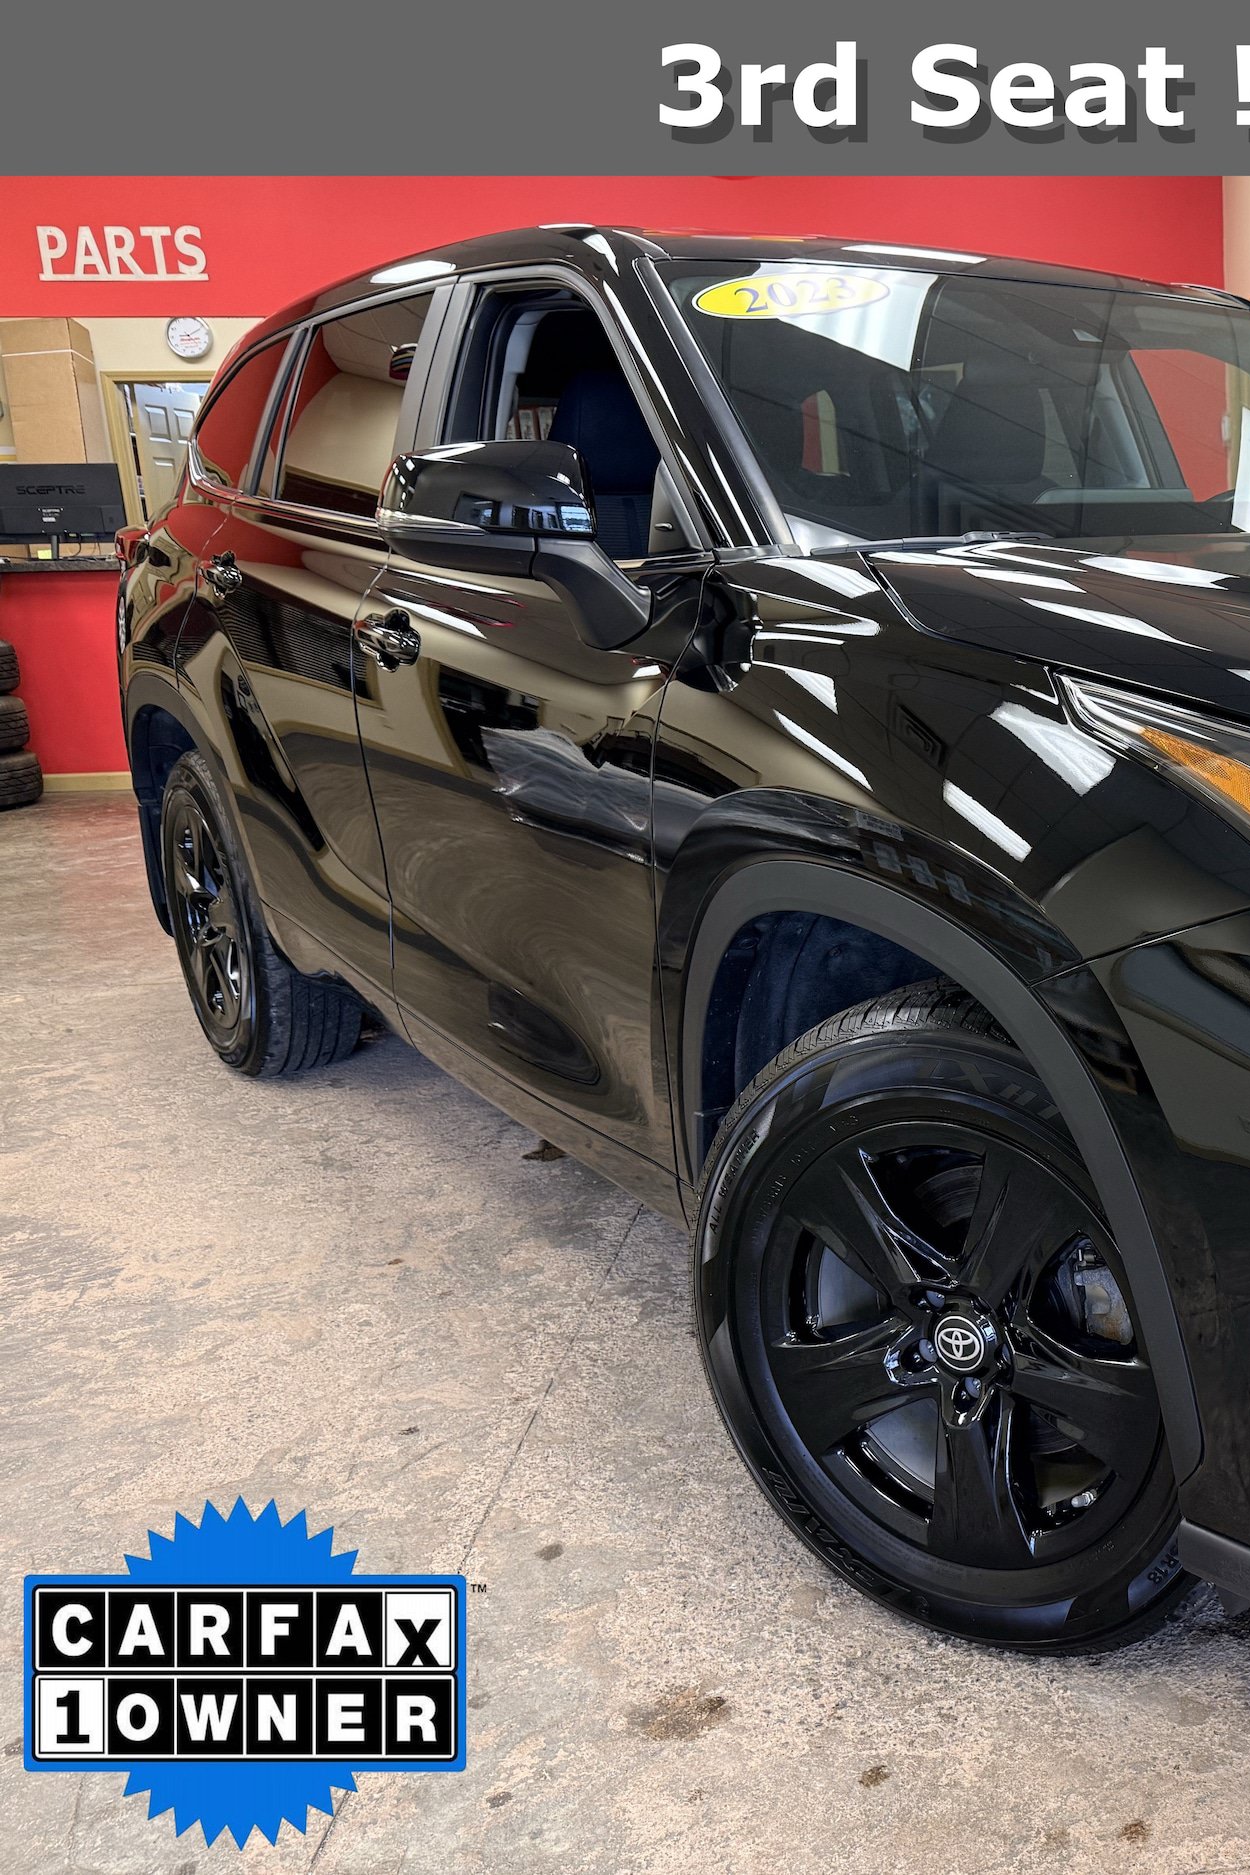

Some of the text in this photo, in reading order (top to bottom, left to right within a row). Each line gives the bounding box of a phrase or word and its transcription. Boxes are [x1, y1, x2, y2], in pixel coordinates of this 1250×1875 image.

[36, 225, 208, 278] PARTS
[734, 276, 855, 313] 2023
[16, 485, 86, 495] SCEPTRE
